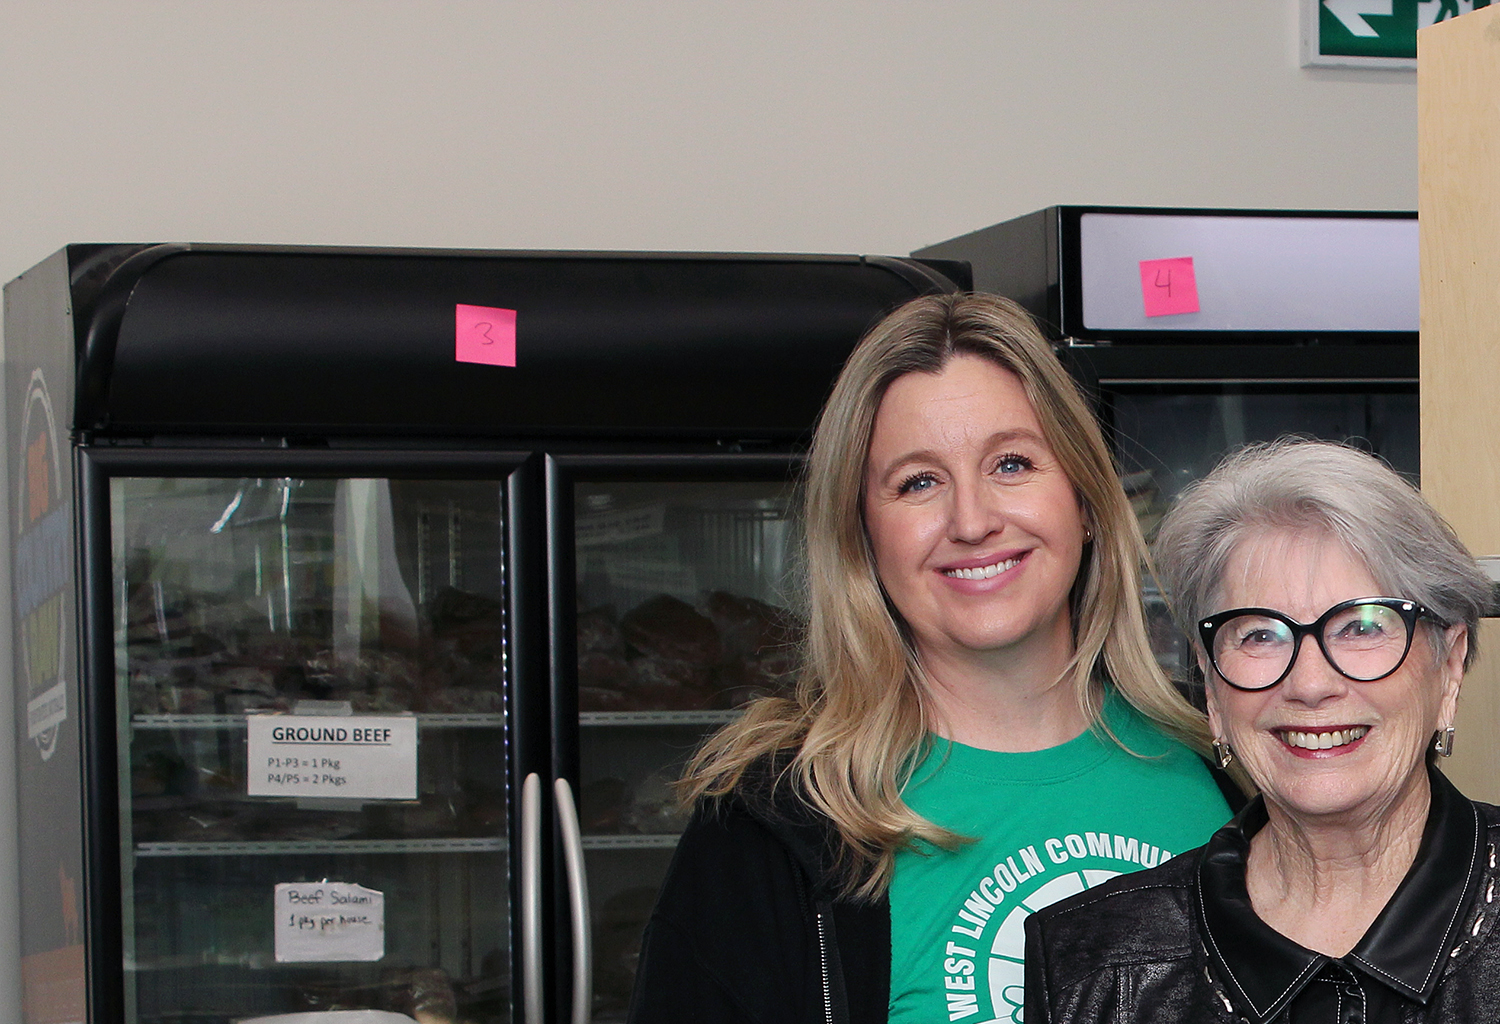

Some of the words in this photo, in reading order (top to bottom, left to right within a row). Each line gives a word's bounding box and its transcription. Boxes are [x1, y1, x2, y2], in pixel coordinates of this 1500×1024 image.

[1154, 268, 1172, 298] 4
[474, 321, 495, 346] 3
[272, 727, 347, 742] GROUND
[352, 728, 391, 742] BEEF
[267, 758, 299, 768] P1-P3
[312, 758, 318, 768] 1
[321, 758, 340, 770] Pkg
[267, 774, 300, 784] P4/P5
[312, 774, 318, 784] 2
[322, 774, 347, 786] Pkgs
[288, 889, 324, 904] Beef
[330, 890, 372, 905] Salami
[952, 845, 1046, 940] LINCOLN
[321, 917, 335, 930] per
[339, 914, 372, 924] house
[944, 941, 979, 1022] WEST
